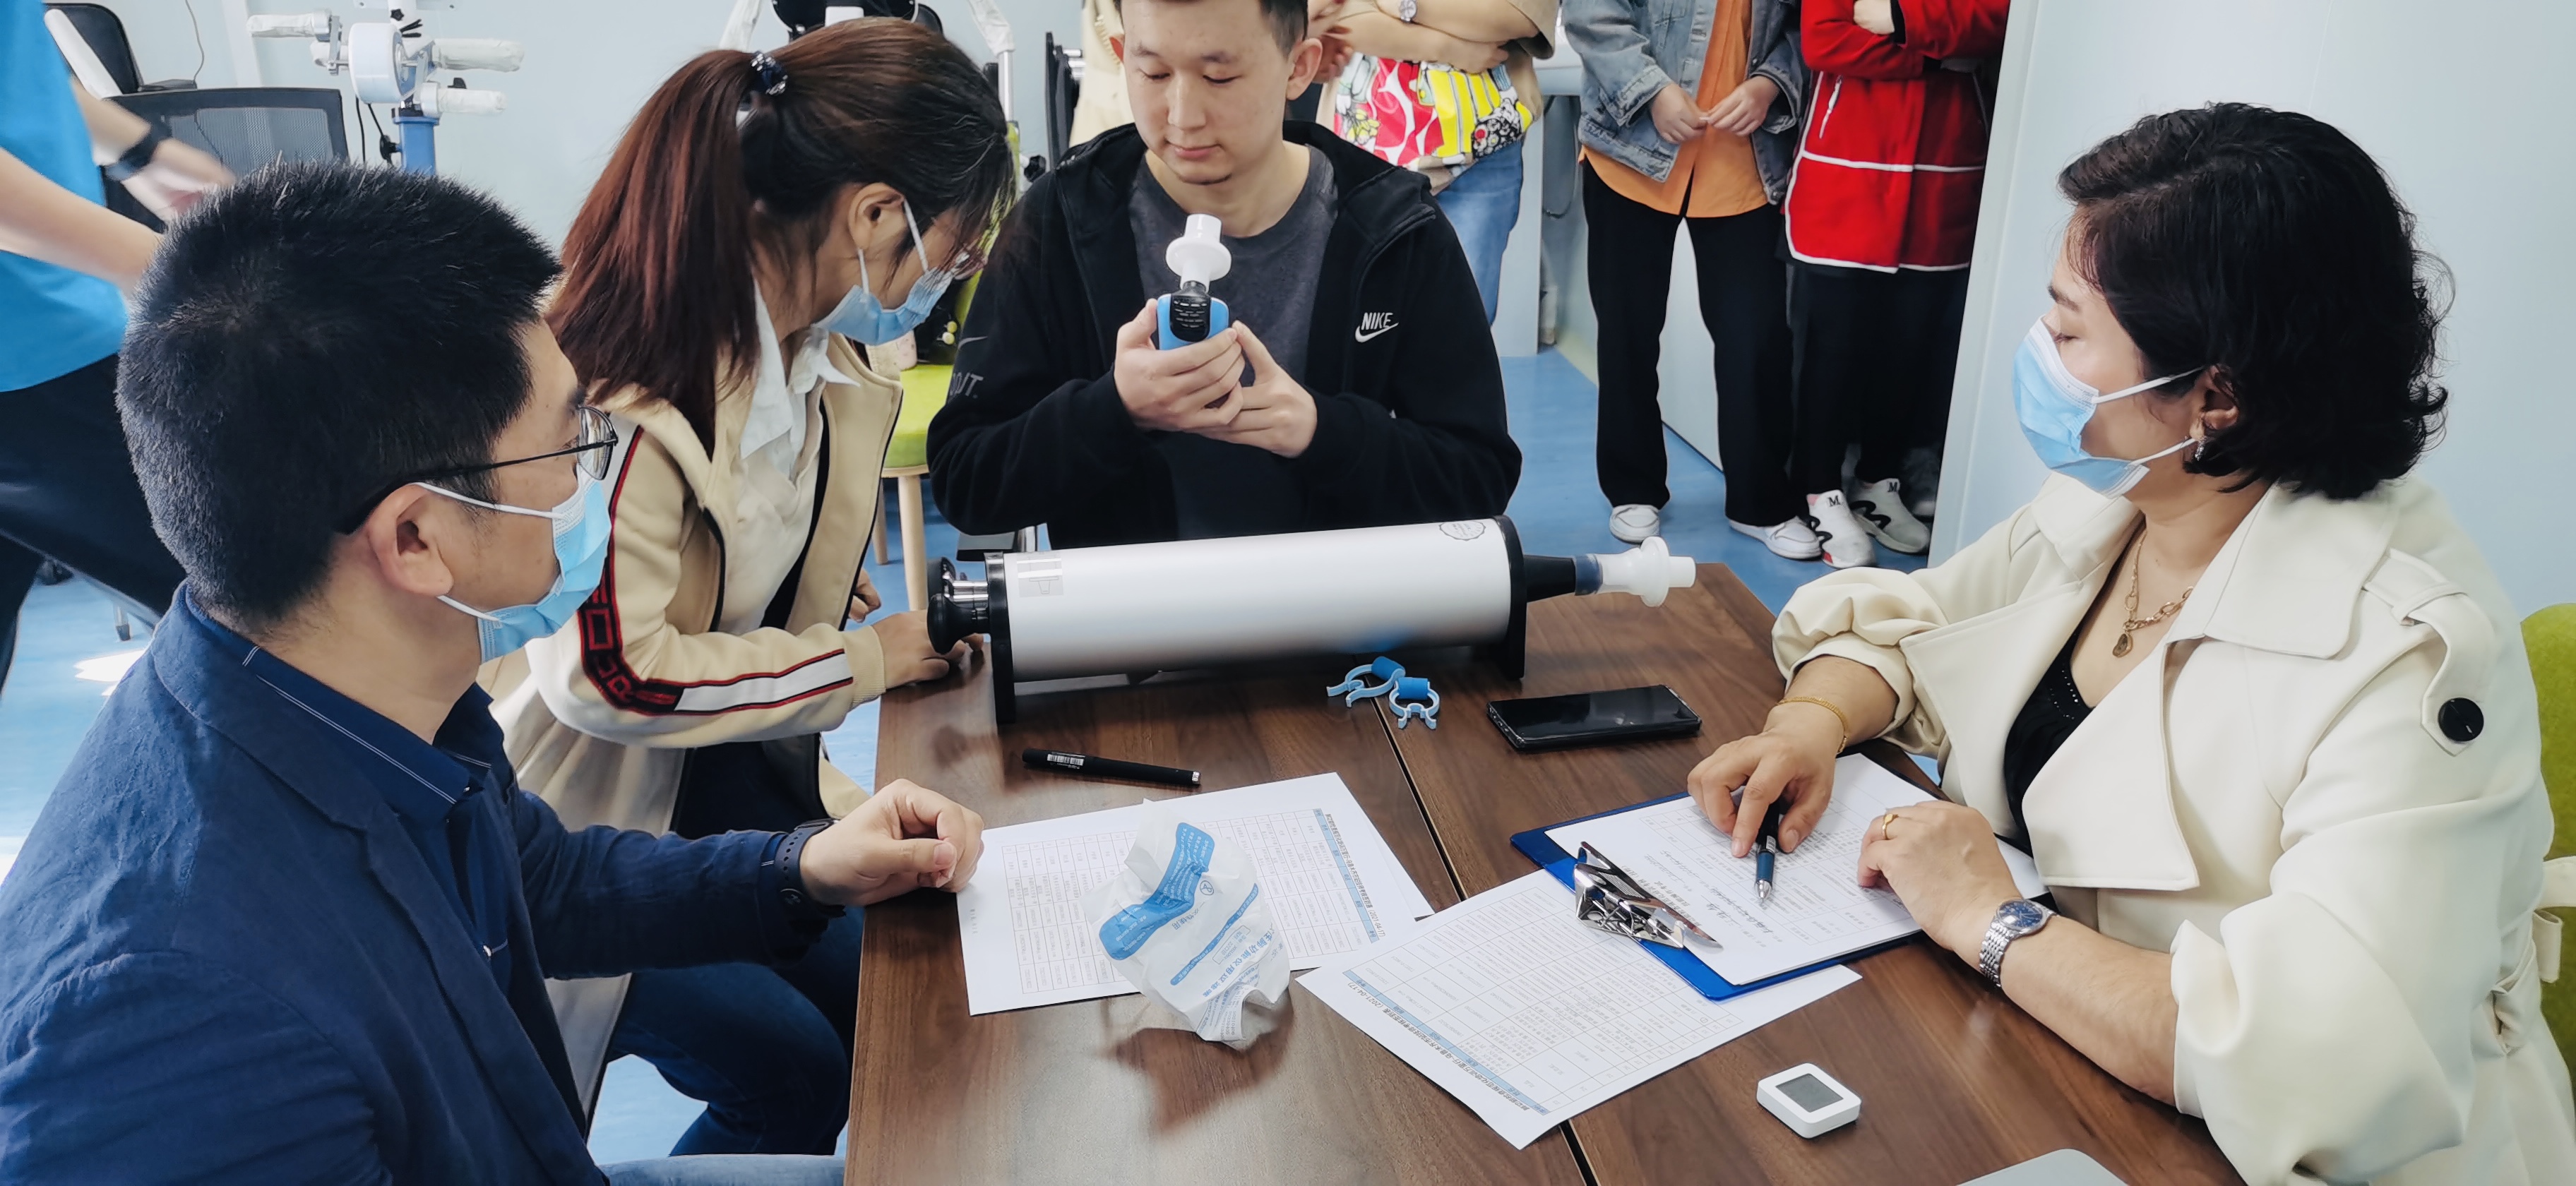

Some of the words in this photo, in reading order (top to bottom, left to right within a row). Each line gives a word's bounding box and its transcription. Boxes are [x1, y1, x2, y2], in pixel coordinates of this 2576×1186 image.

[1361, 312, 1394, 330] NIKE
[1888, 481, 1898, 493] M
[1828, 496, 1842, 507] M
[1652, 880, 1691, 906] 技能操作考试
[1171, 900, 1205, 930] 一次性使用
